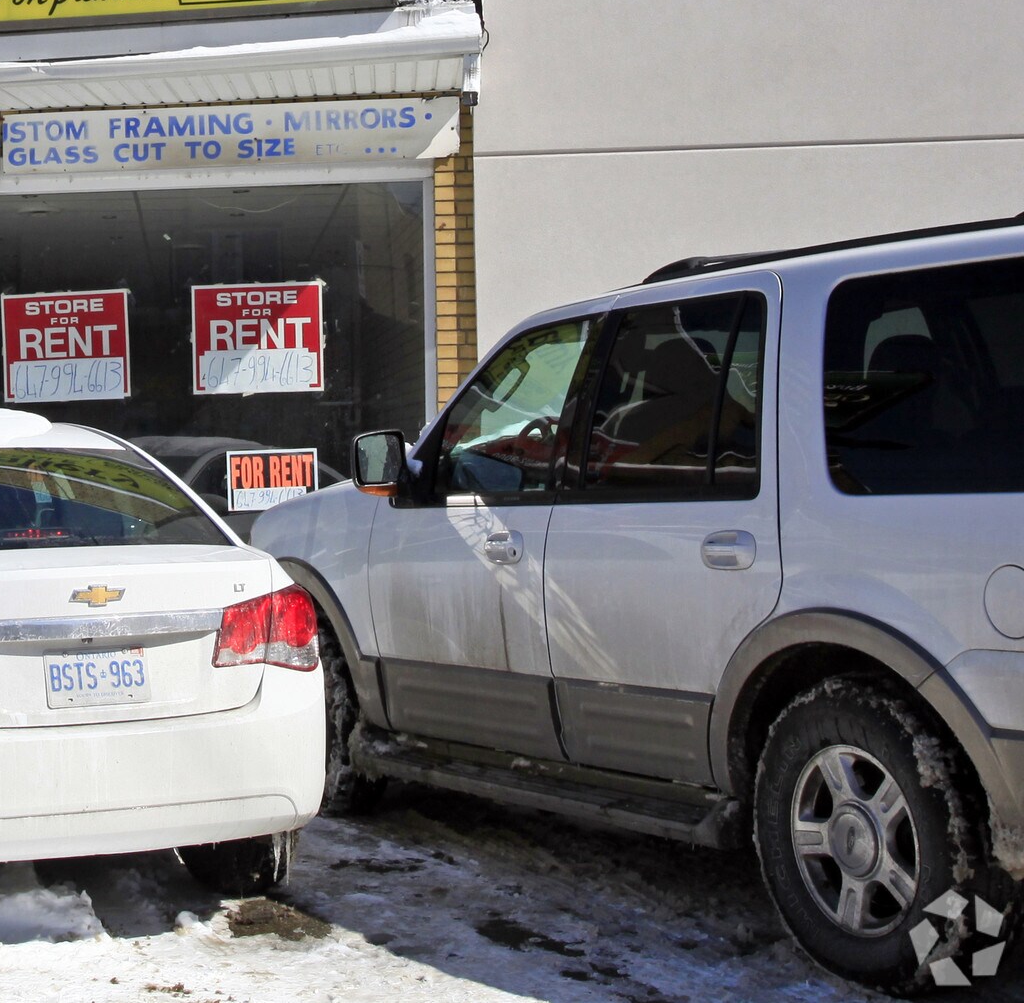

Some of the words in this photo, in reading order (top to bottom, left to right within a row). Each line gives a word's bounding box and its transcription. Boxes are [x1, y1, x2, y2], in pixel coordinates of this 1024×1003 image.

[108, 113, 254, 139] FRAMING
[284, 106, 416, 132] MIRRORS
[8, 145, 99, 167] GLASS
[113, 143, 166, 163] CUT
[185, 140, 221, 160] TO
[237, 138, 295, 159] SIZE
[25, 298, 104, 316] STORE
[216, 290, 298, 308] STORE
[51, 317, 79, 325] FOR
[242, 308, 271, 316] FOR
[19, 324, 118, 359] RENT
[209, 317, 311, 350] RENT
[231, 456, 264, 489] FOR
[269, 454, 313, 487] RENT
[233, 583, 246, 593] LT
[76, 651, 116, 661] ONTARIO
[49, 662, 98, 692] BSTS
[109, 659, 145, 688] 963
